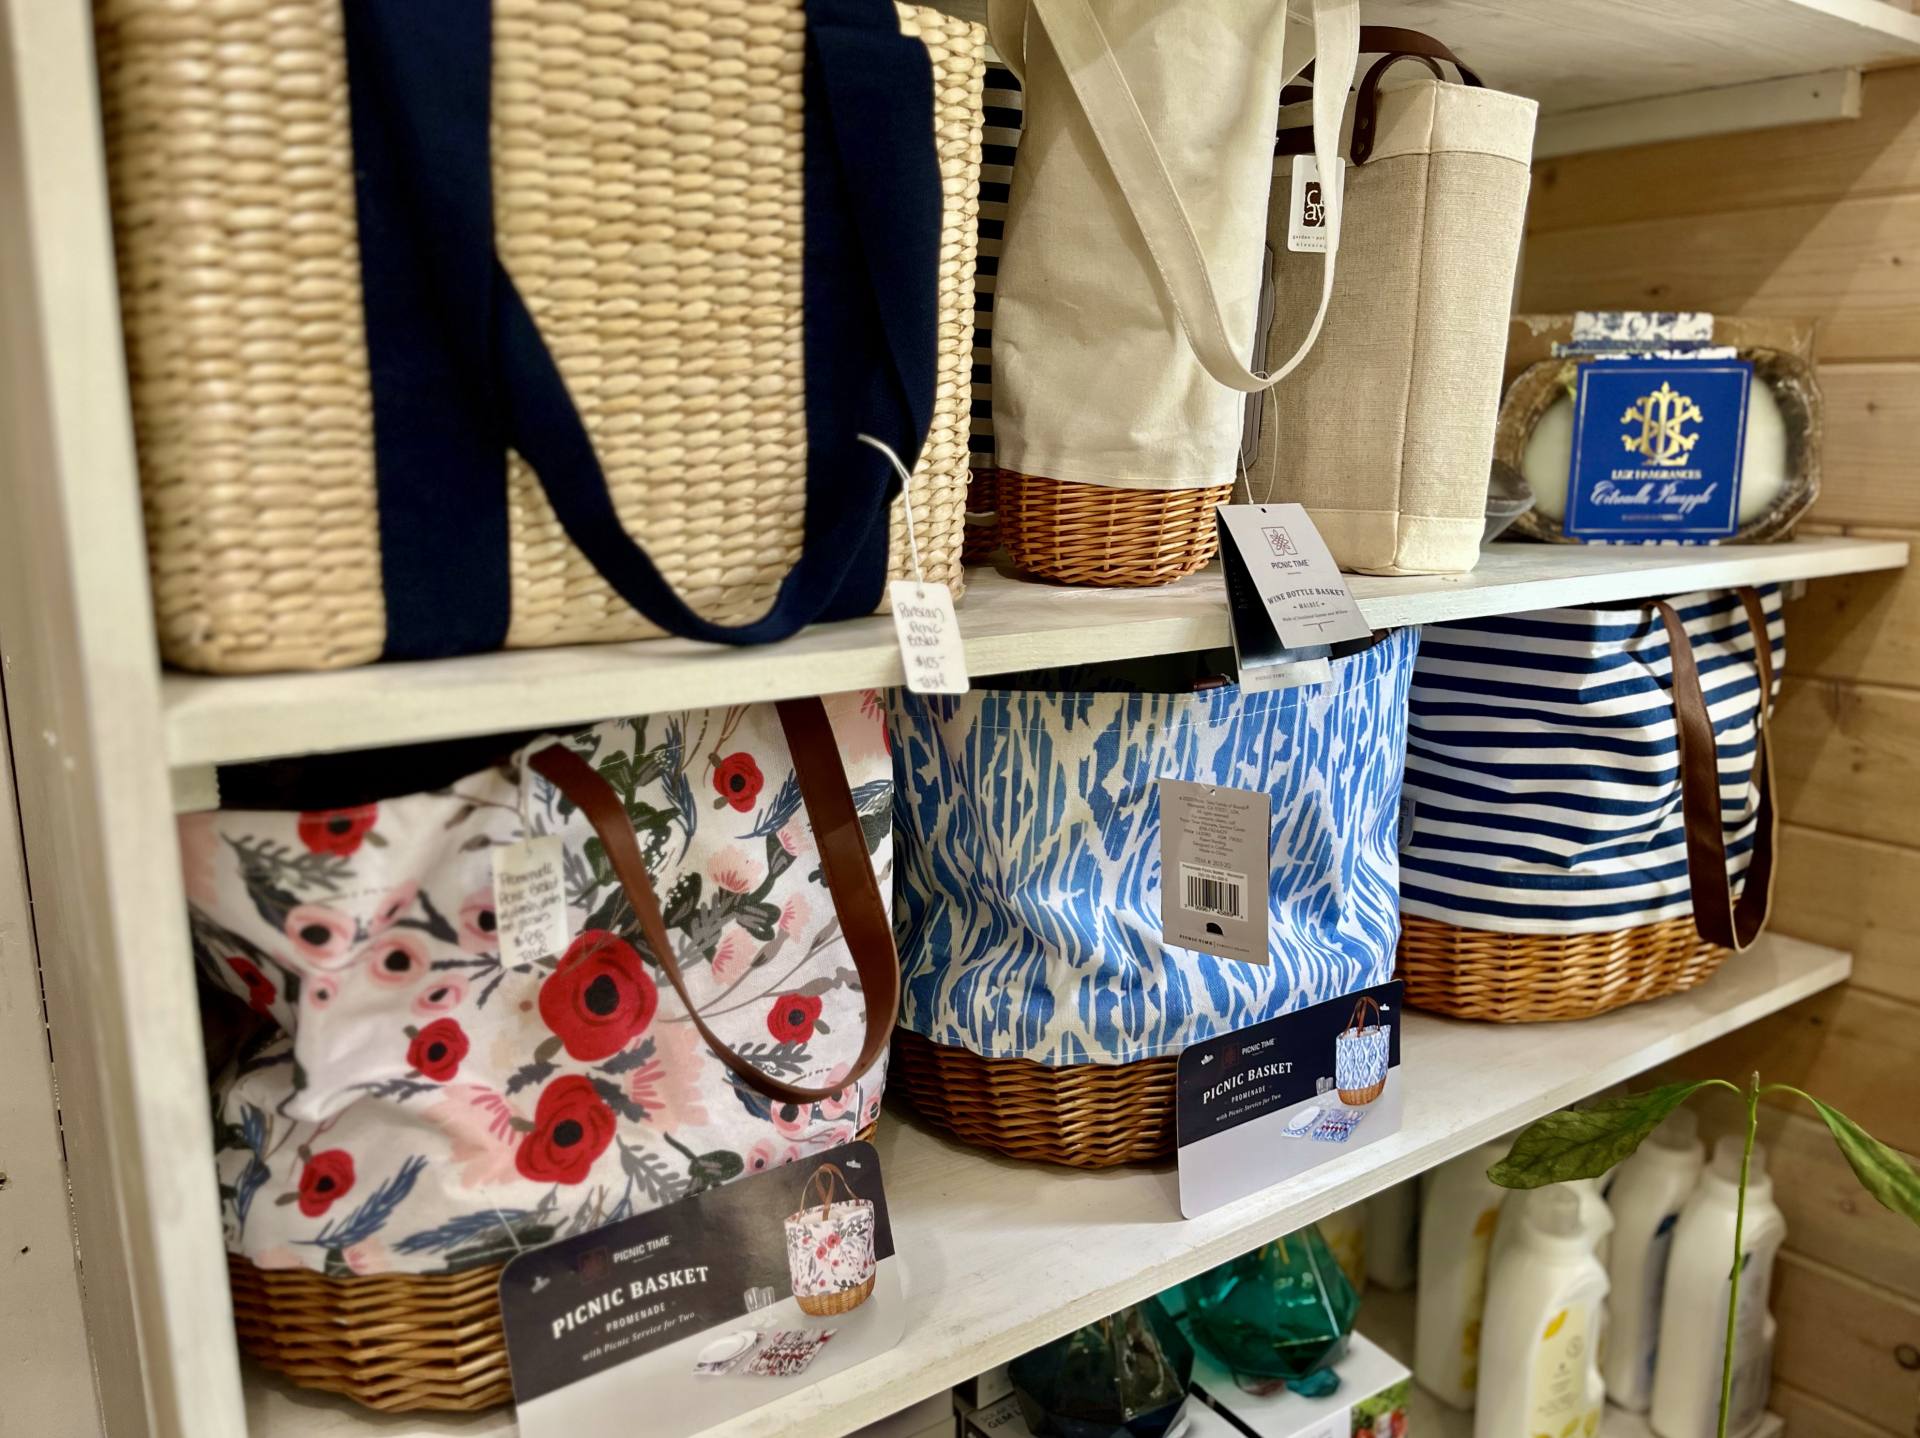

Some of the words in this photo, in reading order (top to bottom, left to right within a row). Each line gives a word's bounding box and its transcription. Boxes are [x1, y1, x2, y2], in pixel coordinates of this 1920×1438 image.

[1271, 560, 1293, 570] PICNIC
[1293, 559, 1309, 568] TIME
[1267, 593, 1286, 605] WINE
[1286, 588, 1314, 599] BOTTLE
[1315, 588, 1345, 597] BASKET
[1241, 1043, 1260, 1055] PICNIC
[1260, 1038, 1275, 1048] TIME
[1203, 1072, 1244, 1104] PICNIC
[1247, 1061, 1293, 1082] BASKET
[1231, 1085, 1266, 1103] PROMENADE
[612, 1244, 646, 1264] PICNIC
[646, 1235, 670, 1251] TIME
[551, 1287, 625, 1340] PICNIC
[629, 1265, 709, 1299] BASKET
[606, 1302, 666, 1333] PROMENADE
[582, 1347, 602, 1361] with
[604, 1337, 630, 1353] Picnic
[631, 1324, 662, 1342] Service
[663, 1318, 677, 1331] for
[678, 1311, 695, 1323] Two
